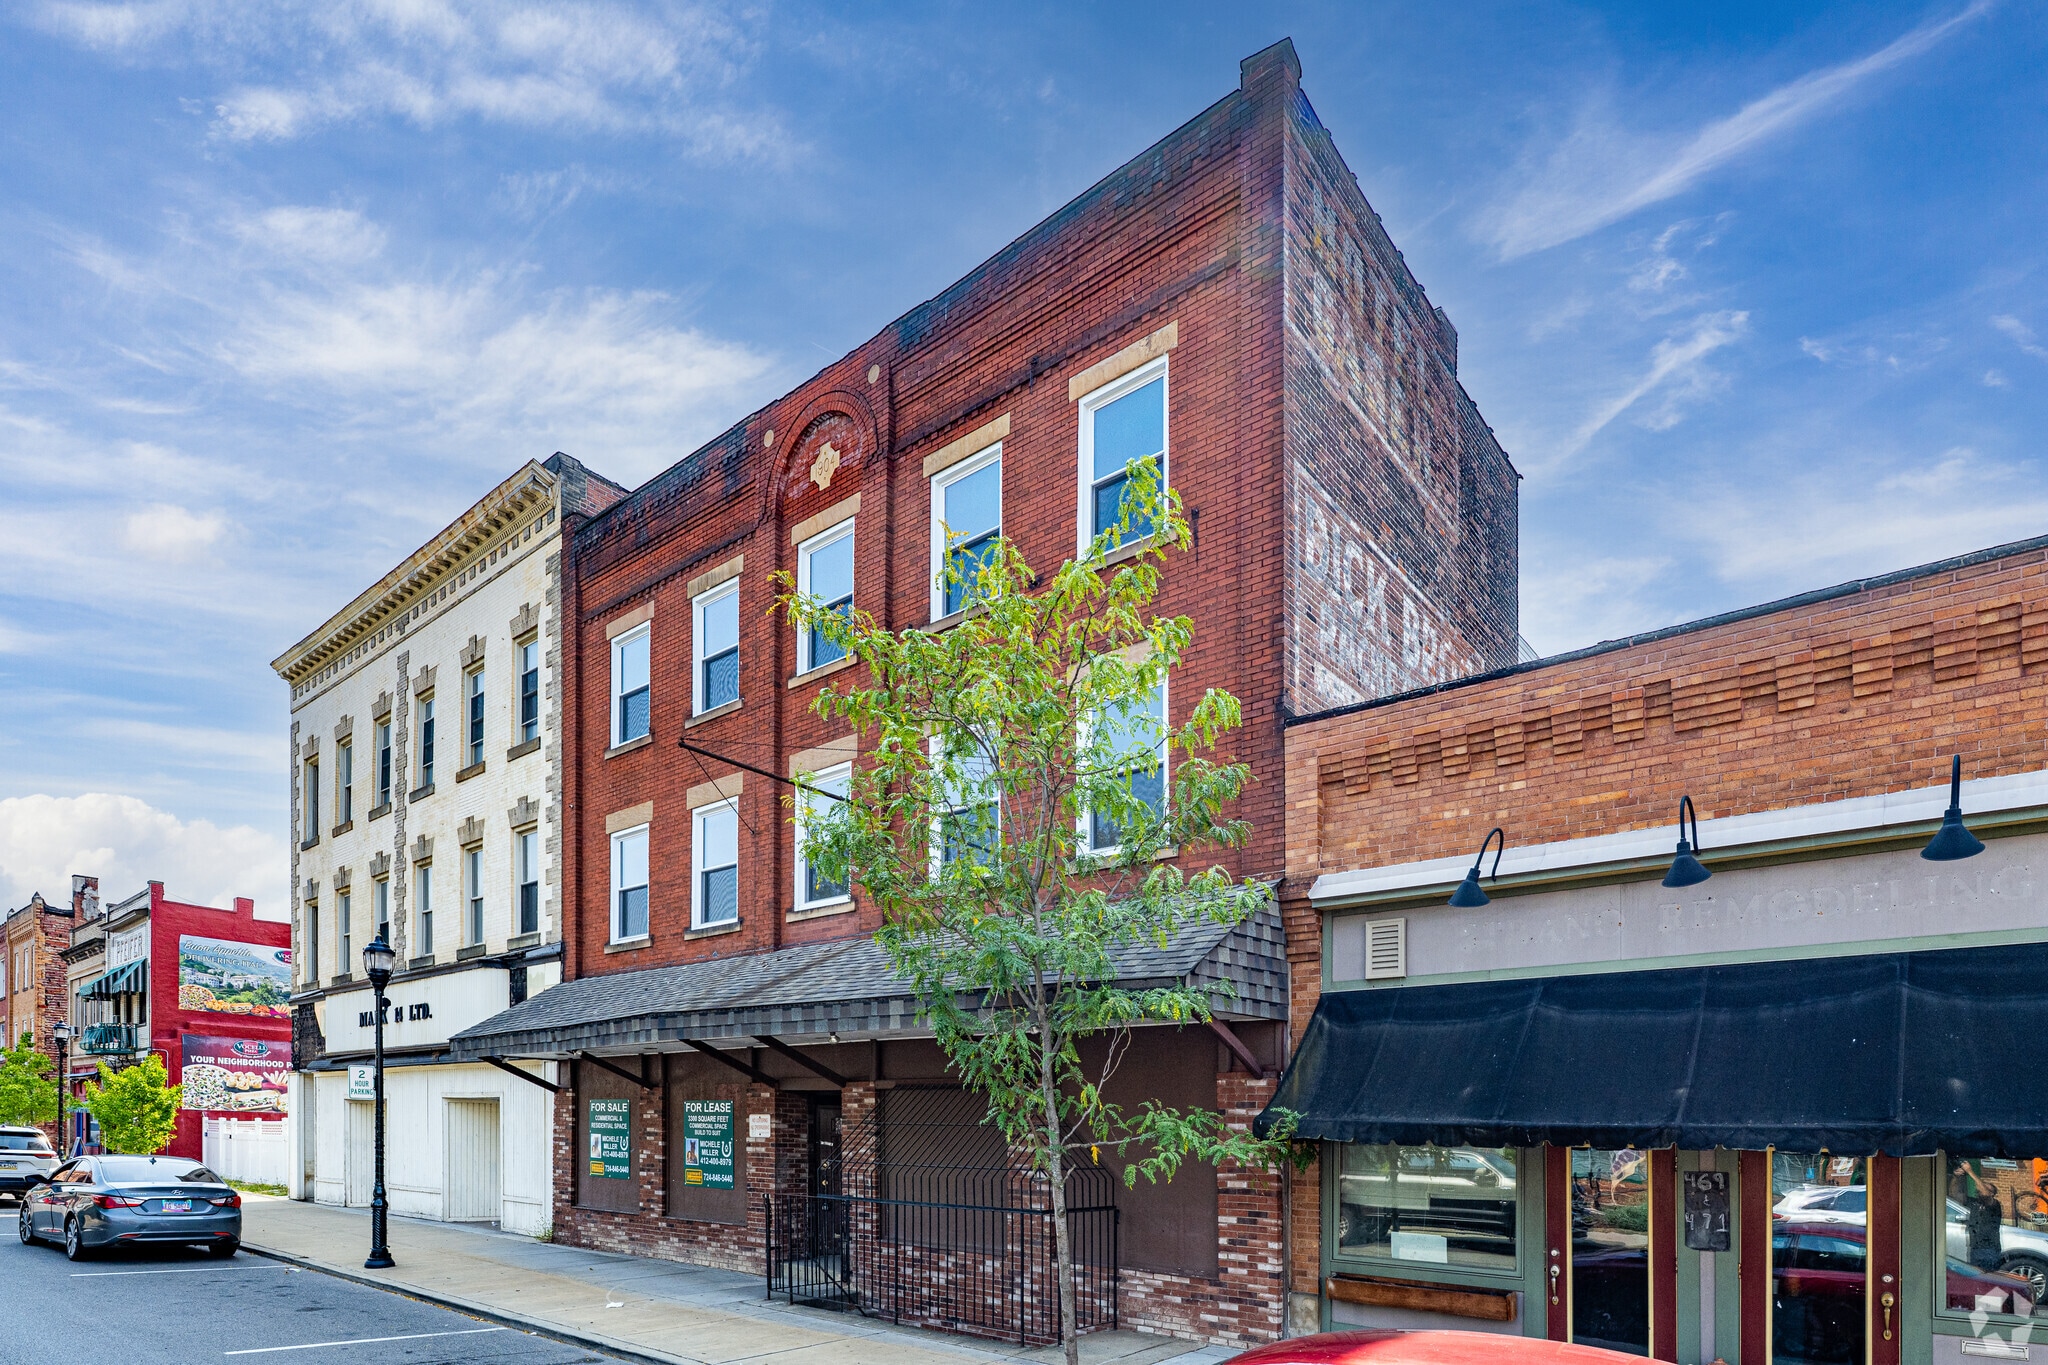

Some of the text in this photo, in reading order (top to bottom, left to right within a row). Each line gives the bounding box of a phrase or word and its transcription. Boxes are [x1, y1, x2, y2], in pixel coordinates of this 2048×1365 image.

[184, 940, 210, 952] Buon
[184, 953, 240, 966] DELIVERING
[241, 960, 266, 968] ITALY
[359, 1008, 388, 1027] MAK
[409, 1003, 432, 1021] LTD.
[190, 1055, 215, 1064] YOUR
[217, 1057, 284, 1068] NEIGHBORHOOD
[358, 1069, 366, 1079] 2
[591, 1103, 628, 1112] FOR SALE
[685, 1102, 731, 1112] FOR LEASE
[700, 1140, 720, 1148] MICHELE
[1684, 1172, 1725, 1191] 469
[1685, 1212, 1729, 1232] 471
